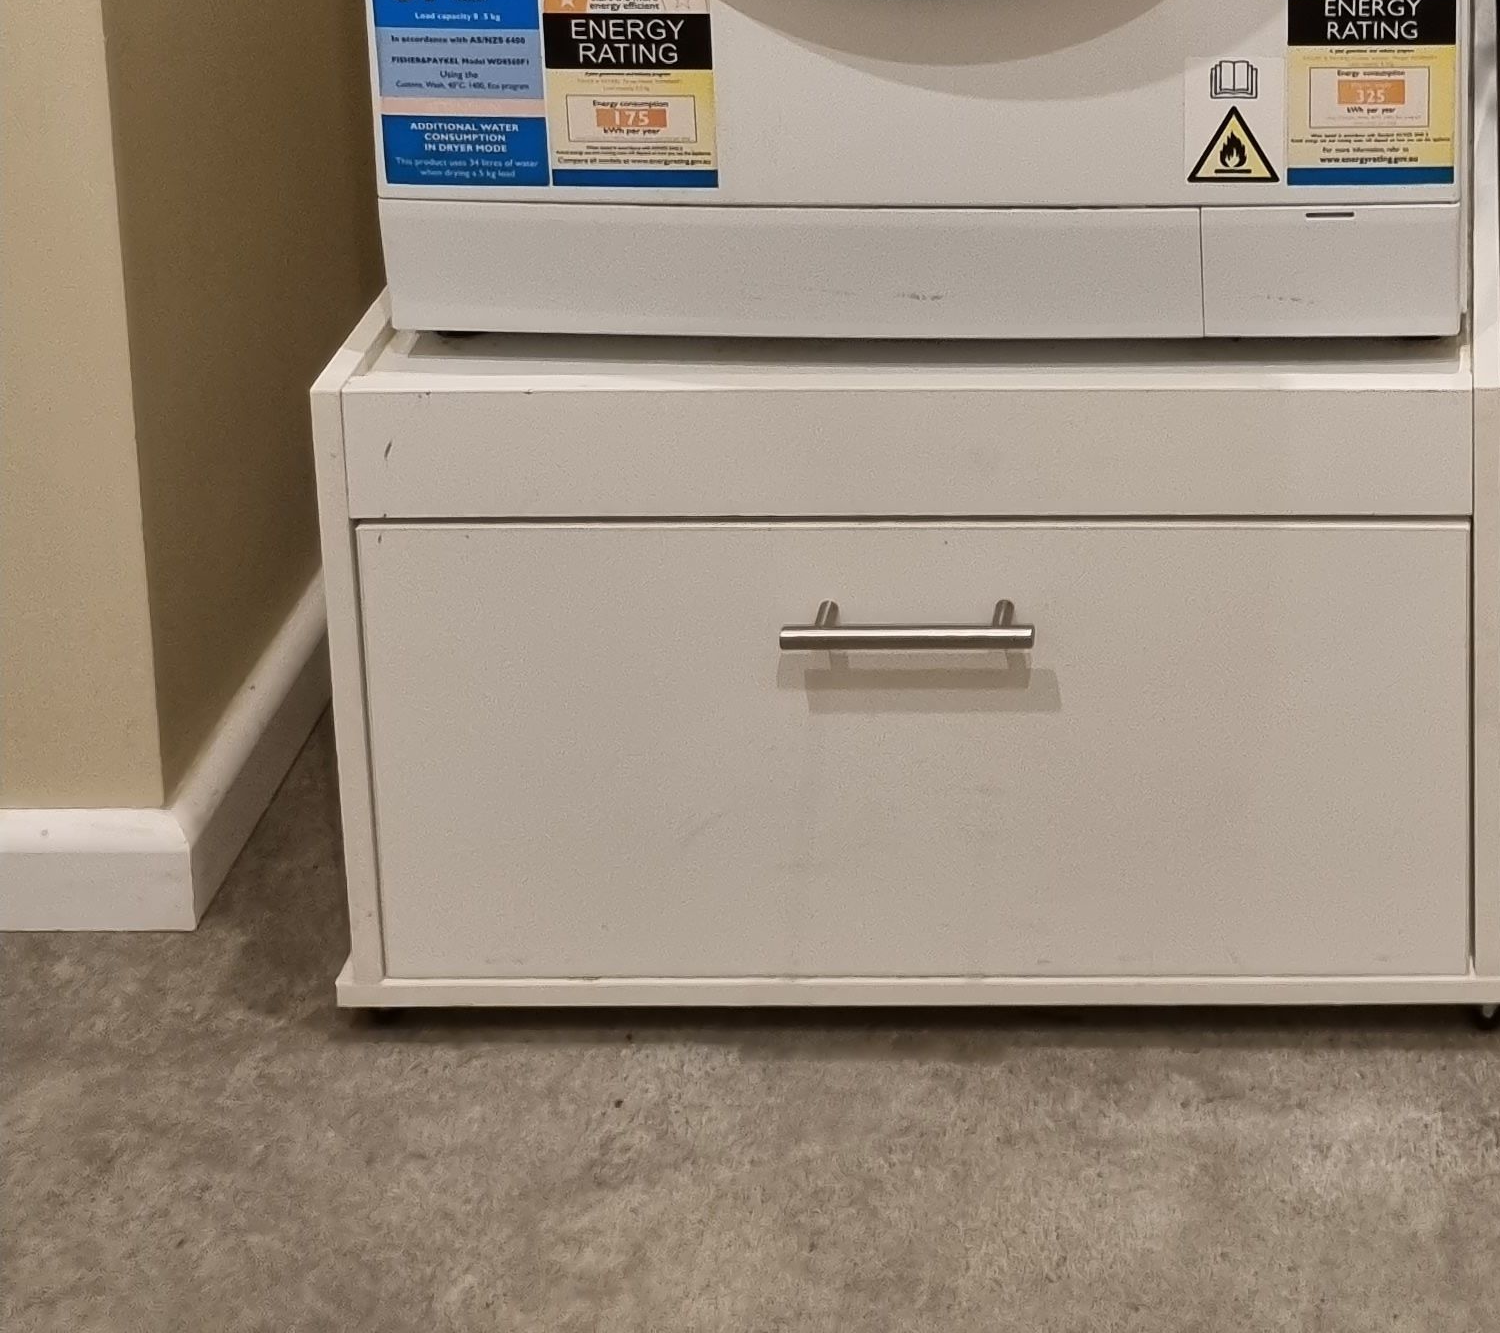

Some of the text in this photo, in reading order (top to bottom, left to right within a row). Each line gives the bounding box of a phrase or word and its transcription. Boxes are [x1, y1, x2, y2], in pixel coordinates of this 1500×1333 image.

[590, 2, 660, 11] energy efficient
[571, 19, 685, 41] ENERGY
[1327, 21, 1418, 40] RATING
[578, 43, 678, 64] RATING
[440, 71, 463, 80] Using
[1356, 89, 1386, 103] 325
[592, 100, 618, 108] Energy
[614, 110, 650, 126] 175
[410, 122, 519, 132] ADDITIONAL WATER
[424, 133, 506, 142] CONSUMPTION
[424, 143, 508, 153] IN DRYER MODE
